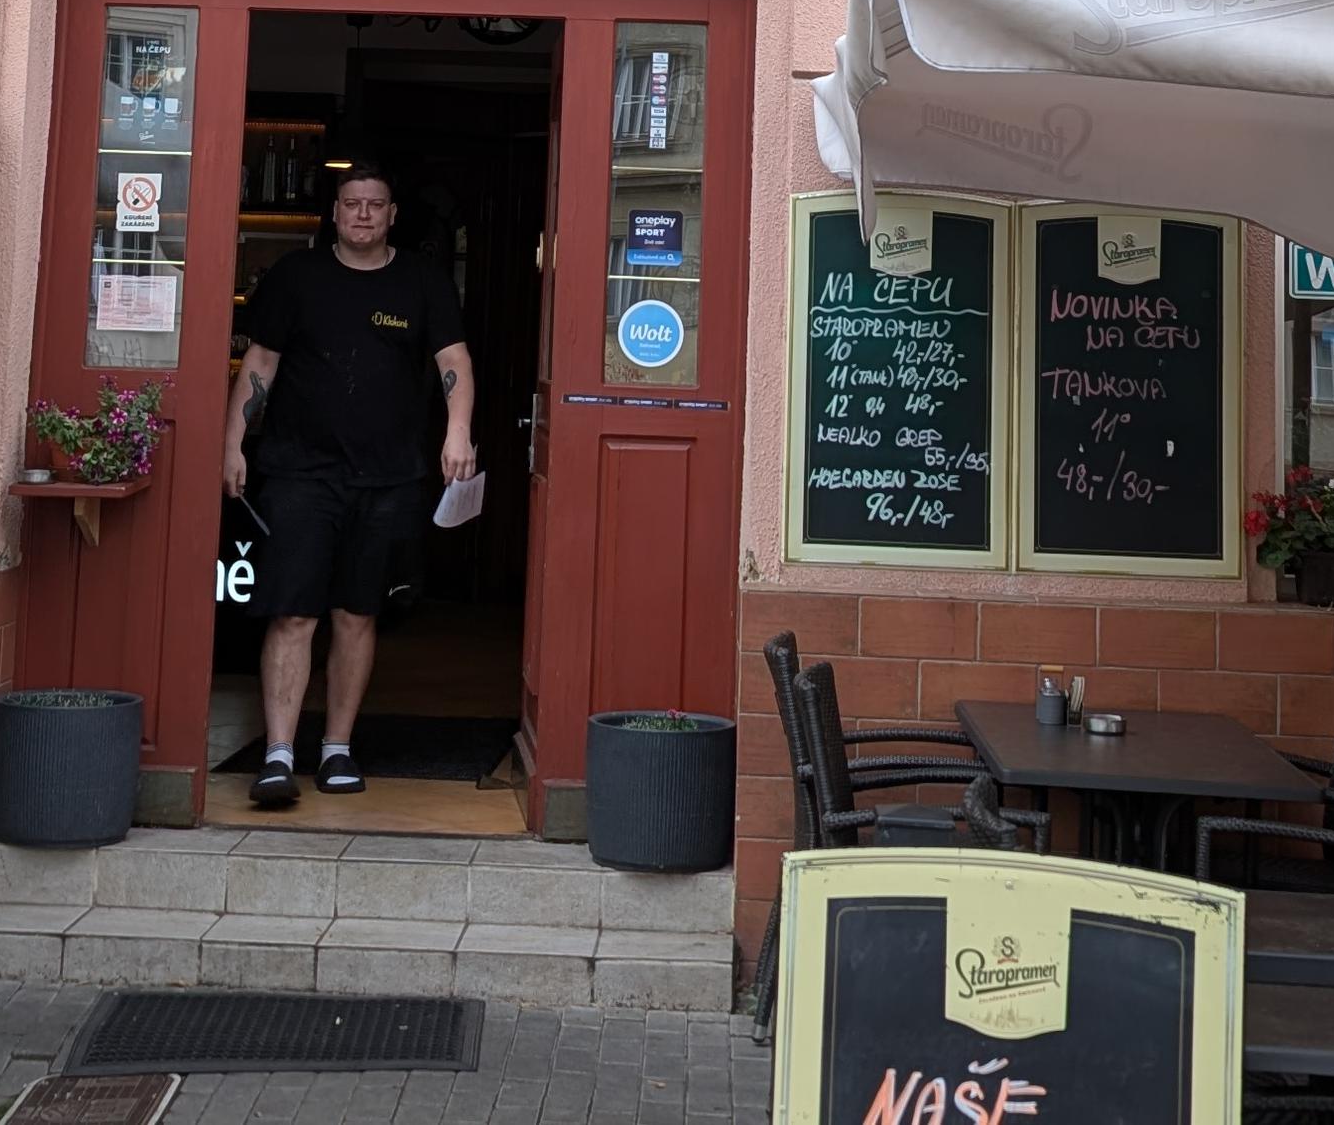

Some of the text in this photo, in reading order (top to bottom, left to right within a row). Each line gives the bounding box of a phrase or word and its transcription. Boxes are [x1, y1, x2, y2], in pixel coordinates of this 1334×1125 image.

[635, 215, 676, 228] oneplay
[635, 228, 665, 236] SPORT
[819, 272, 954, 307] NA ČEPU
[1050, 289, 1178, 322] NOVINKA
[629, 323, 673, 342] Wolt
[810, 316, 951, 338] STAROPRAMEN
[1086, 325, 1124, 352] NA
[1041, 367, 1167, 400] TANKOVA
[817, 423, 881, 447] NEALKO
[955, 948, 1061, 1000] Staropramen
